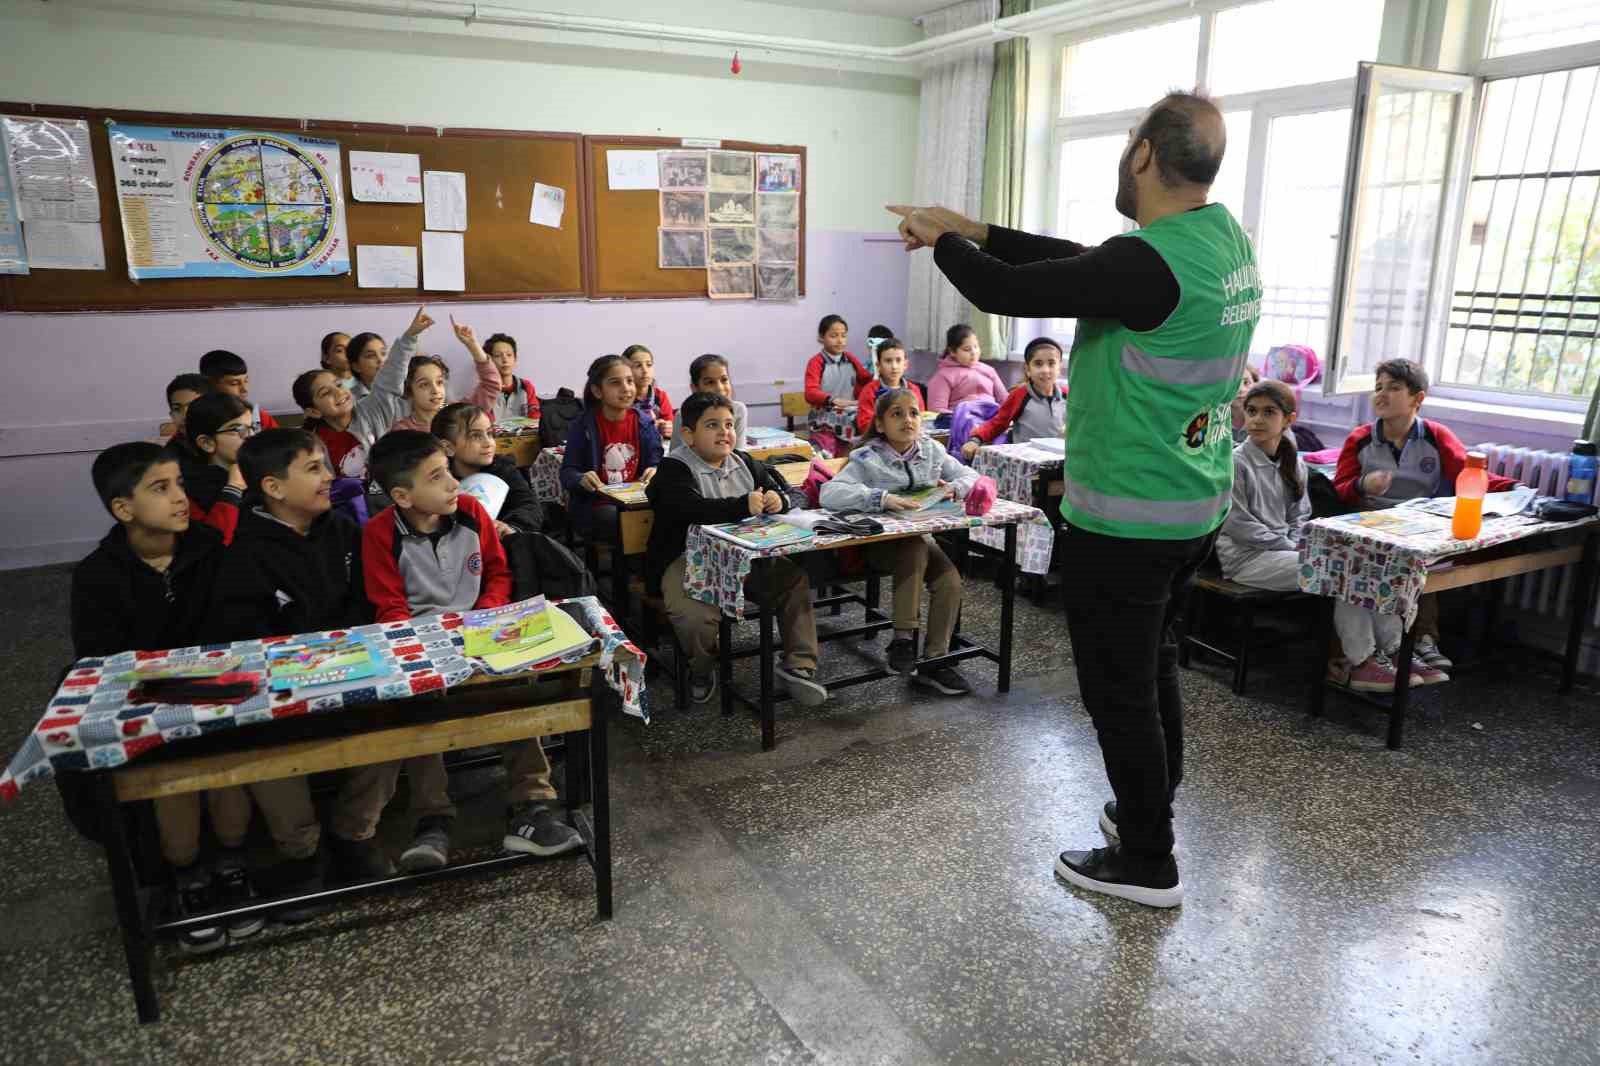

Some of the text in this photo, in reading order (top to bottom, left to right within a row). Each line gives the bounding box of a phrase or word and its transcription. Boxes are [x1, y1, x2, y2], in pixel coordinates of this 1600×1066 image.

[298, 136, 337, 145] TABL
[129, 156, 166, 165] mevsim
[133, 168, 145, 176] 12
[140, 180, 174, 189] gündür
